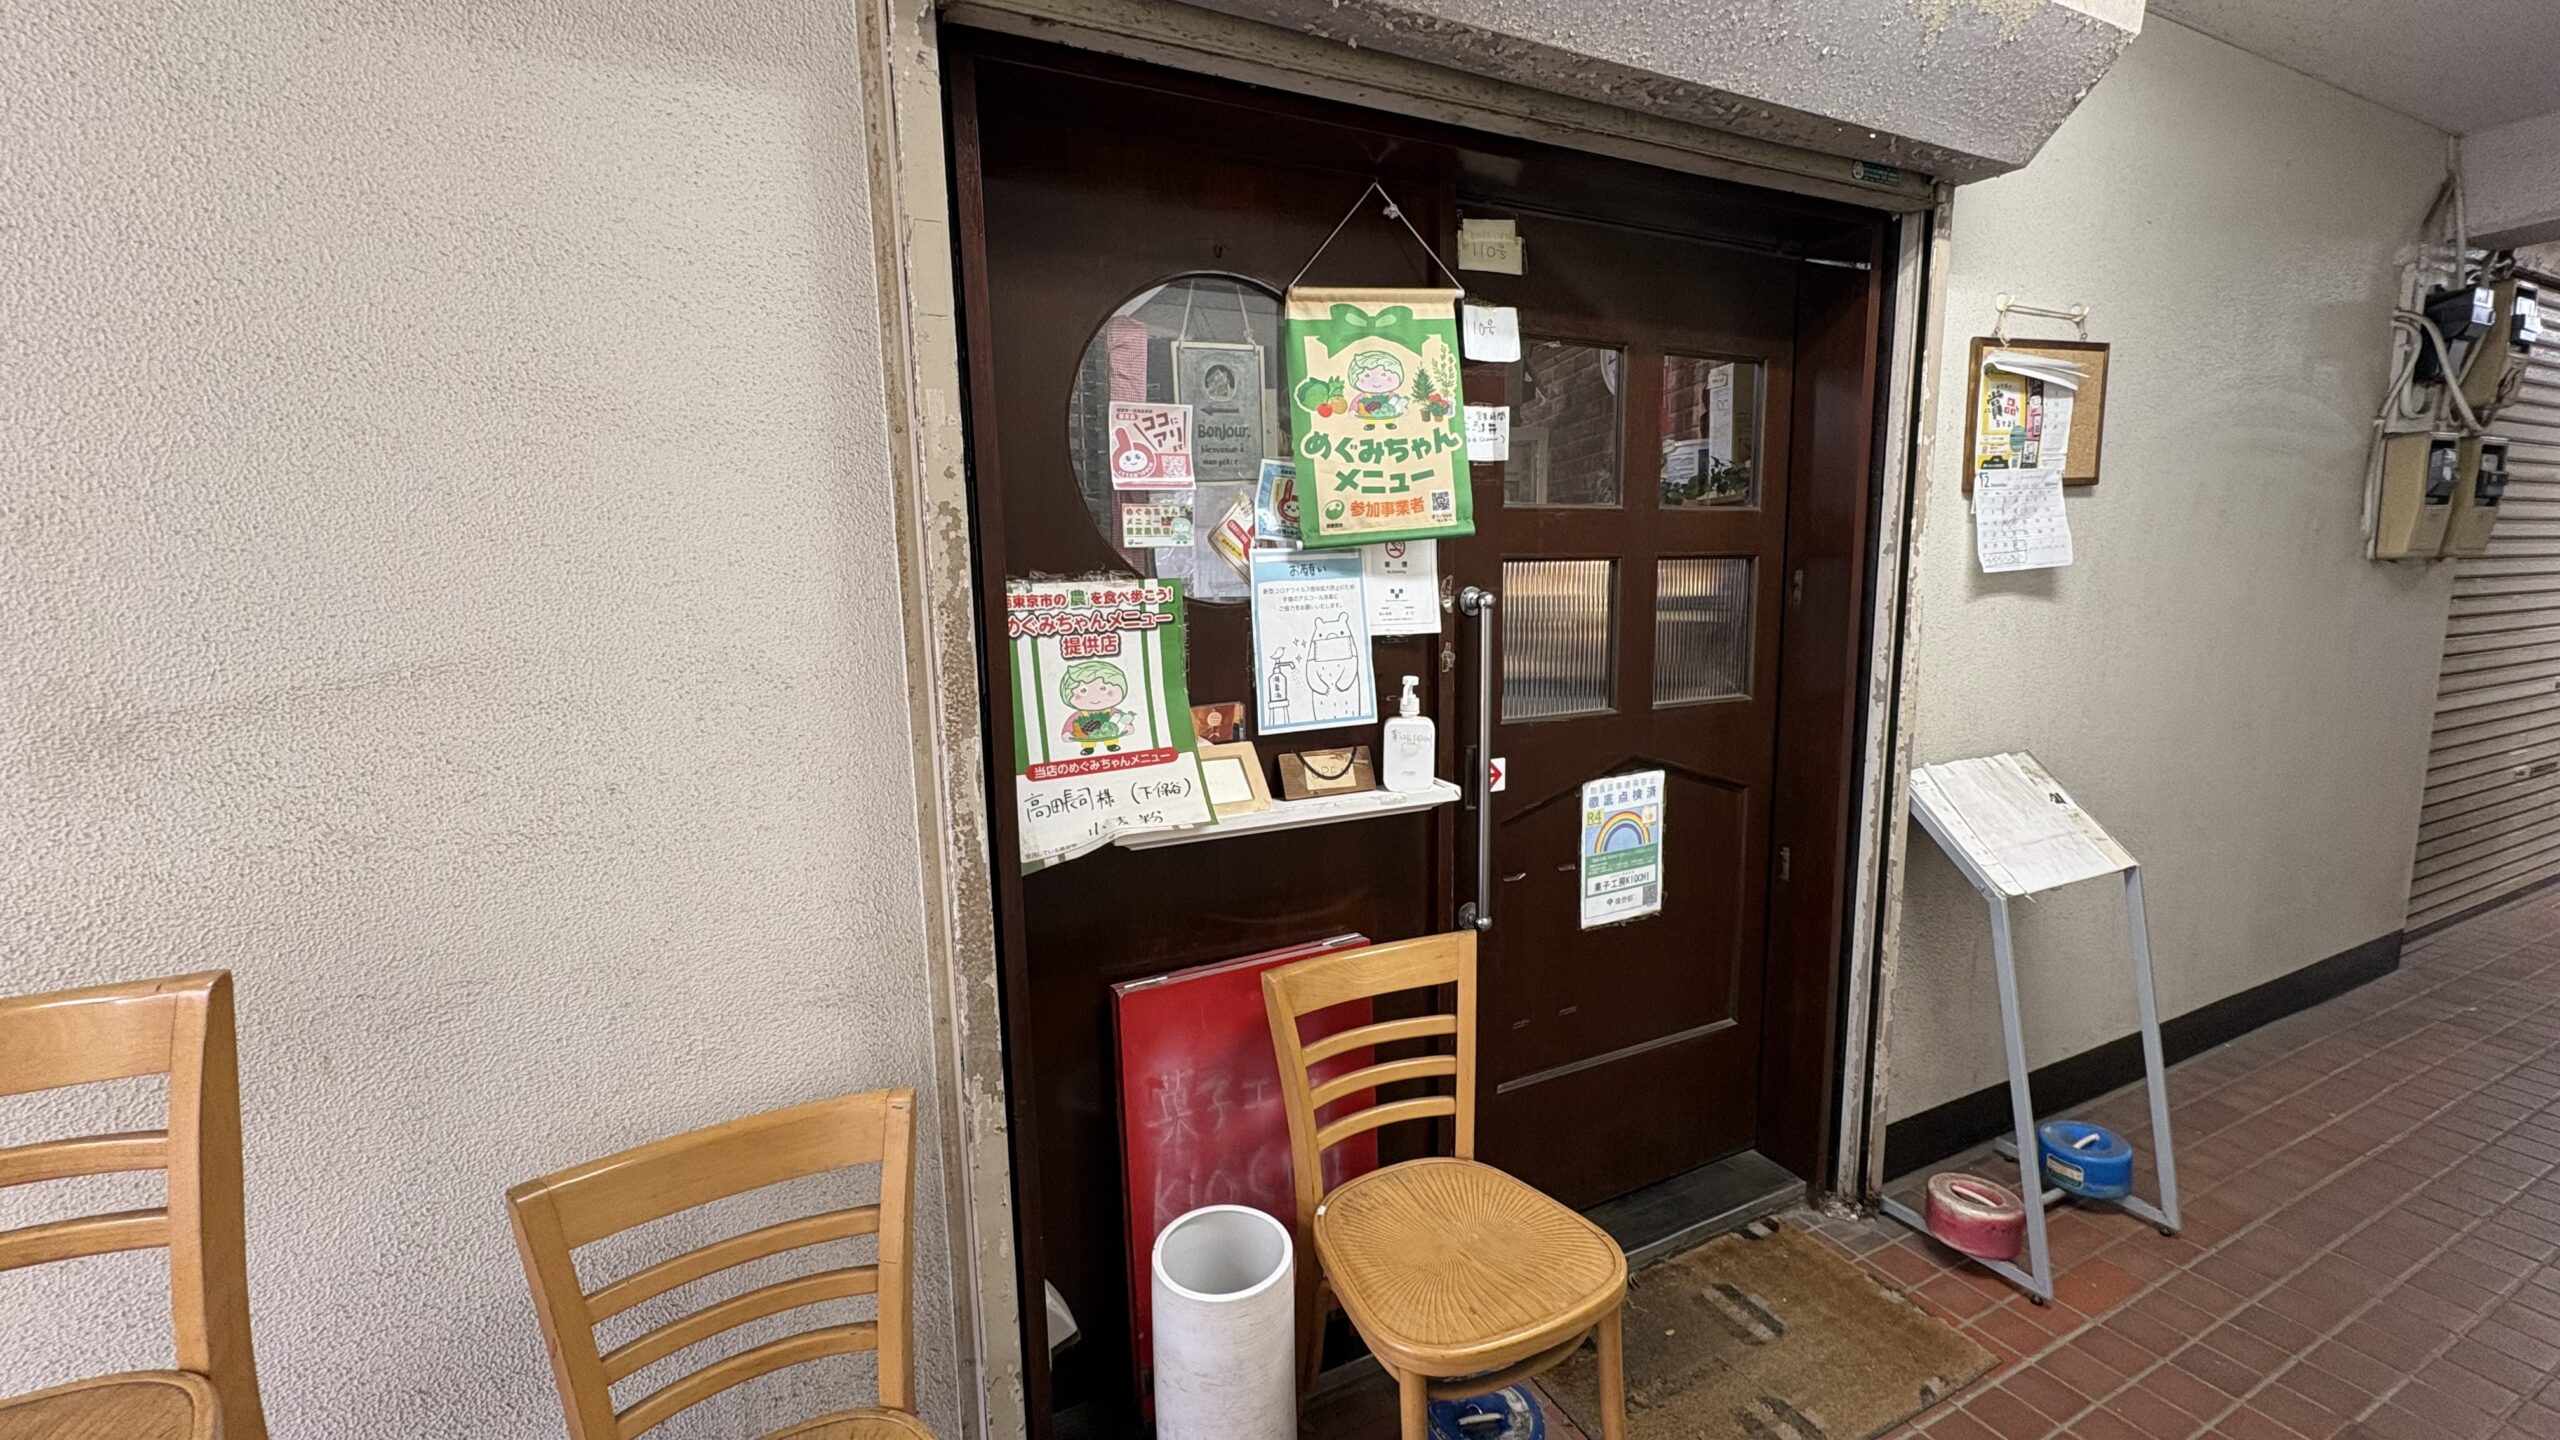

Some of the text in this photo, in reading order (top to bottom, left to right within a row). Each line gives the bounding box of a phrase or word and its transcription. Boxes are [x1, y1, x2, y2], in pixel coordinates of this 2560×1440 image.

[1304, 427, 1459, 464] めぐみちゃん
[1334, 469, 1435, 493] メニュー
[1350, 496, 1425, 518] 参加事業者
[1289, 563, 1327, 577] お願い
[1063, 634, 1118, 656] 提供店
[1034, 752, 1171, 778] 当店のめぐみちゃんメニュー
[1589, 786, 1656, 808] 徹底点検済
